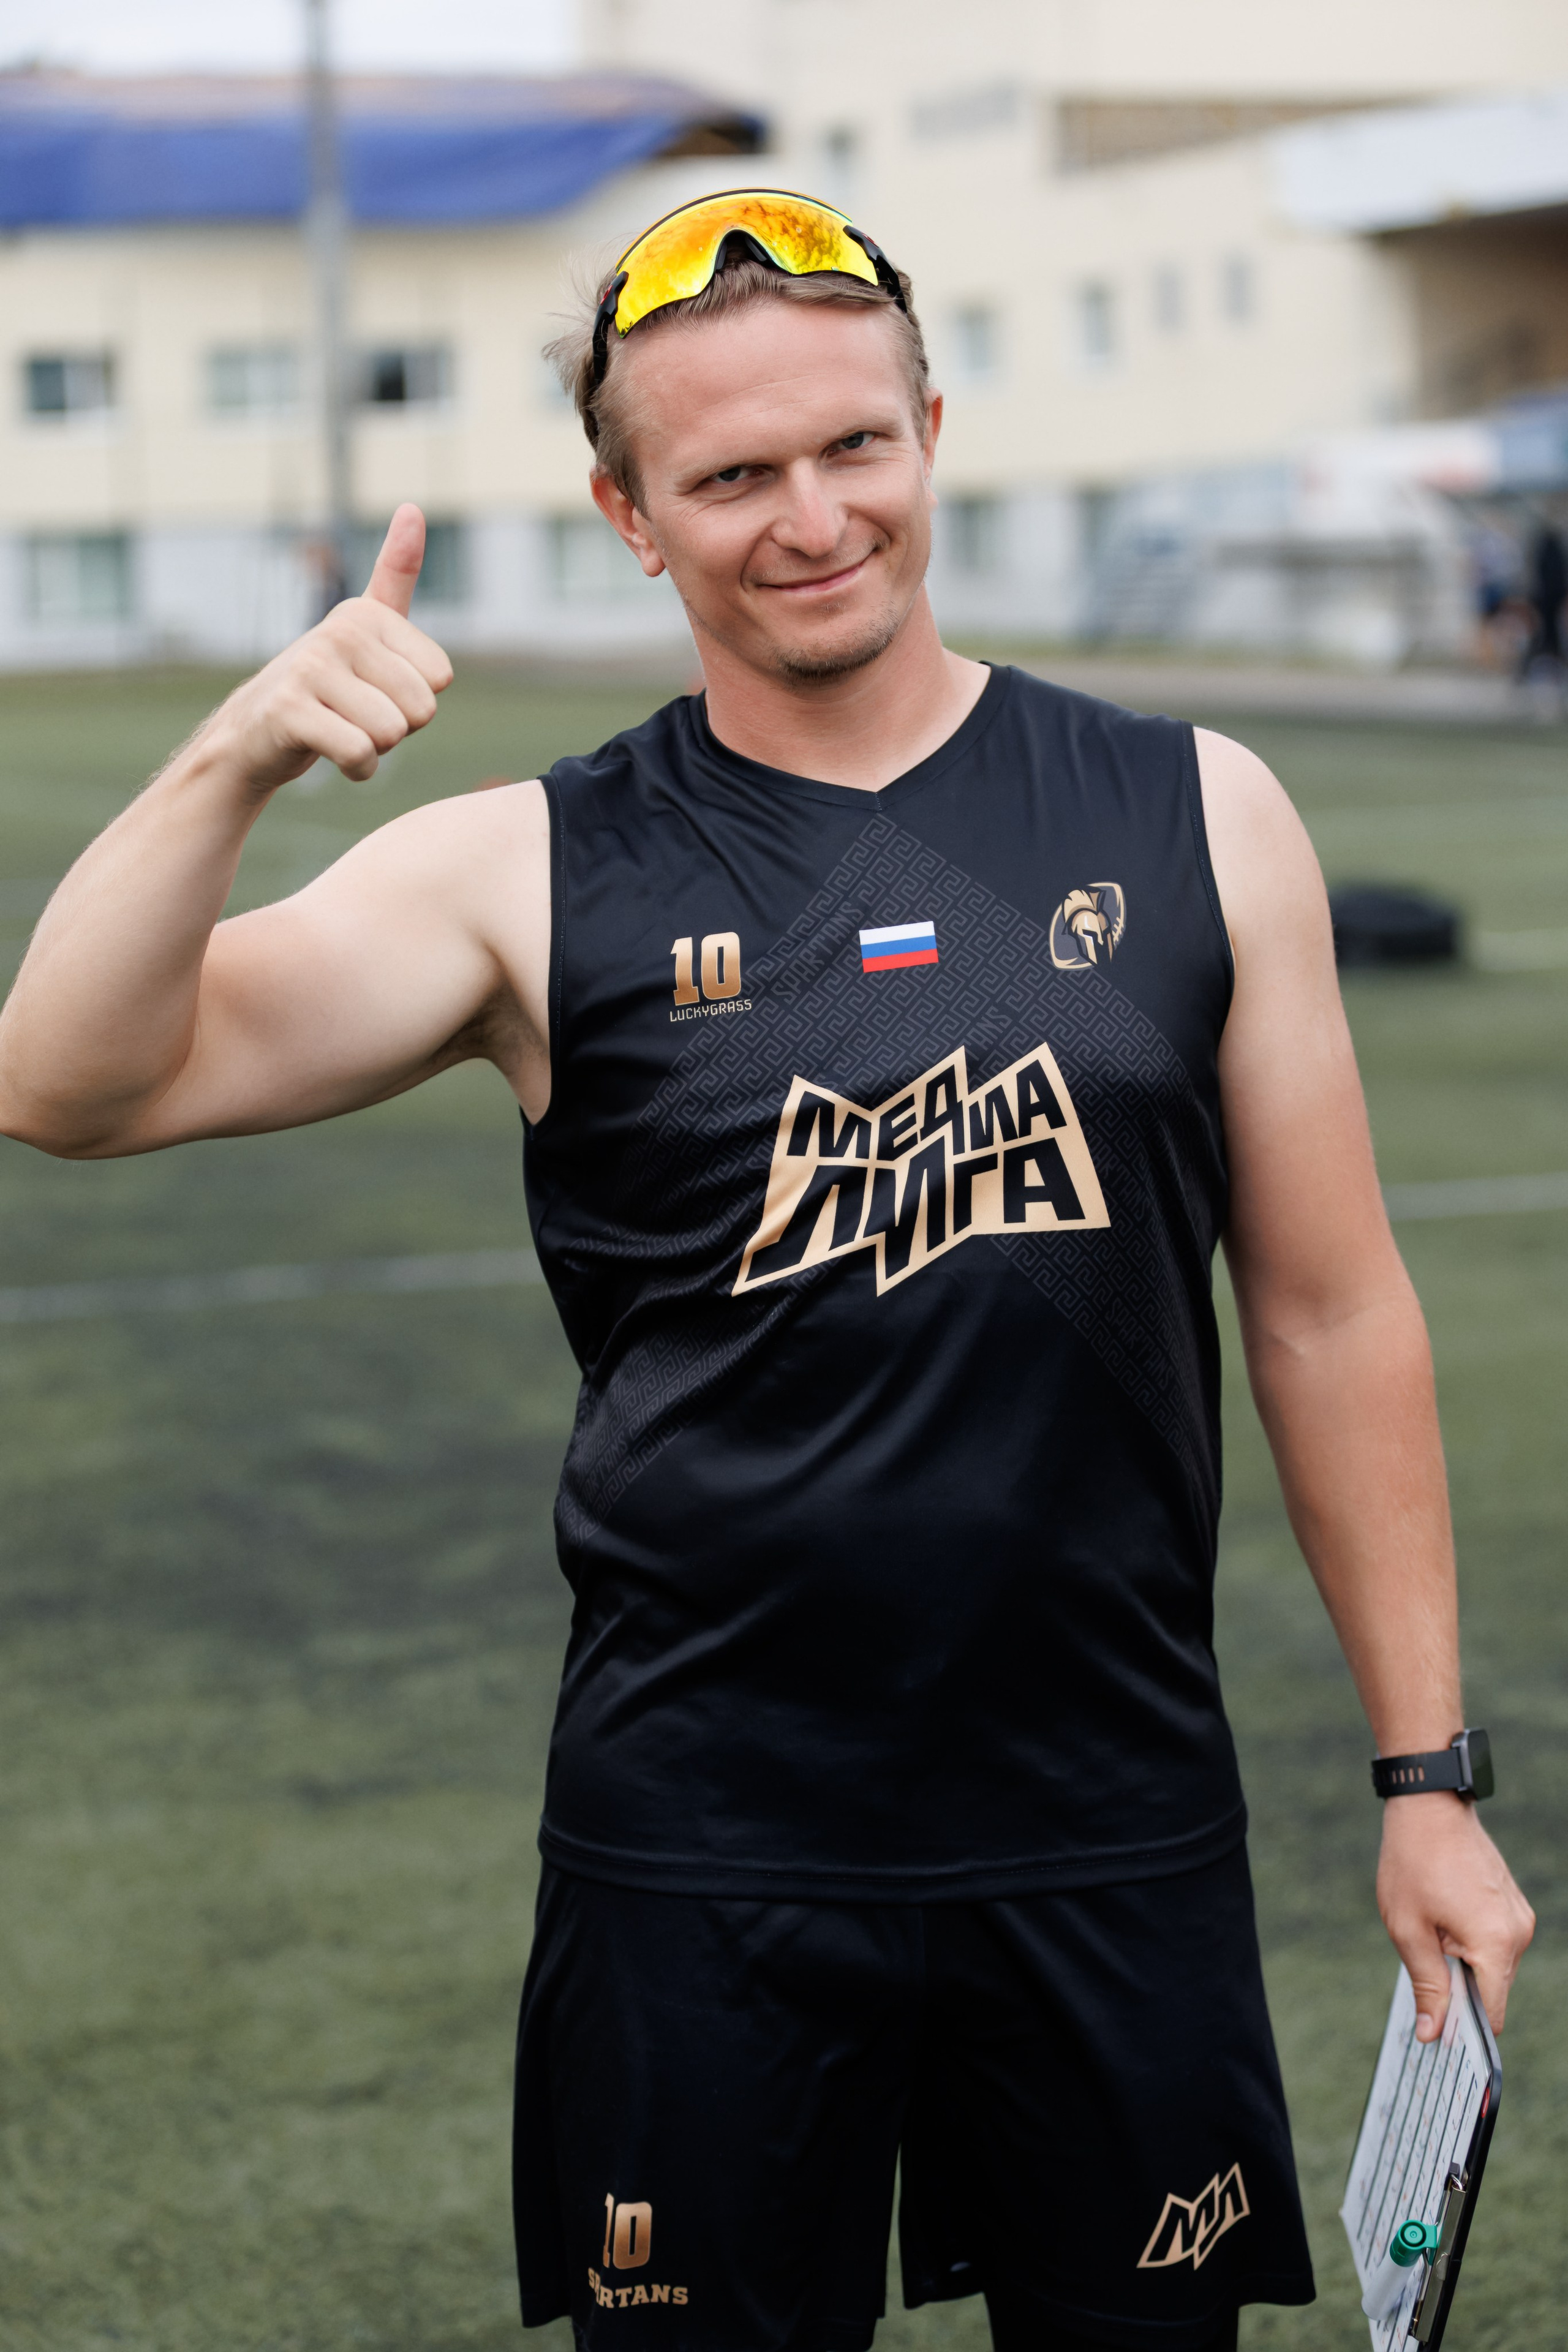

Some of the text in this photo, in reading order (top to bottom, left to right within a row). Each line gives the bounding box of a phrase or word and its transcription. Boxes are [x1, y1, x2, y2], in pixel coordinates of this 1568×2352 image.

[670, 932, 741, 1006] 10
[770, 900, 865, 1006] SPARTANS
[669, 999, 753, 1022] LUCKYGRASS
[786, 1058, 1068, 1161] МЕДИА
[744, 1134, 1087, 1281] ЛИГА
